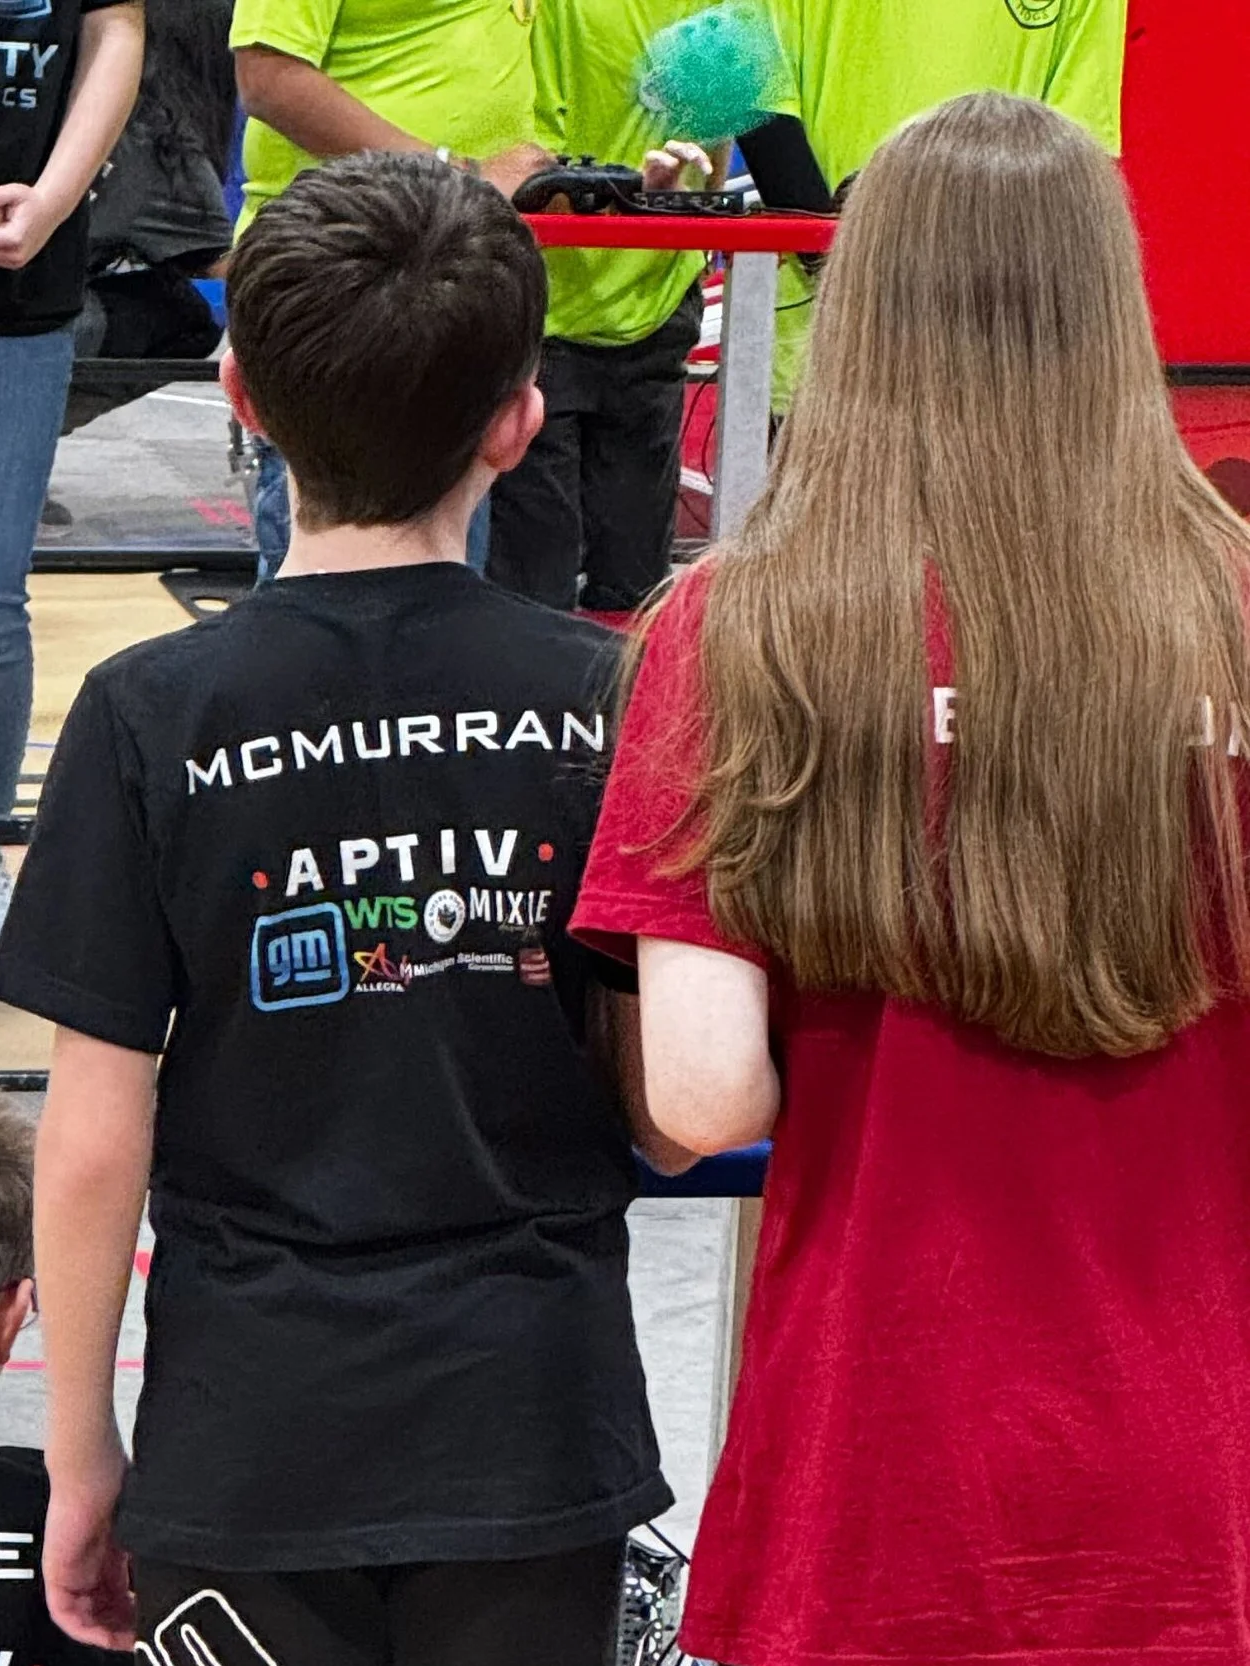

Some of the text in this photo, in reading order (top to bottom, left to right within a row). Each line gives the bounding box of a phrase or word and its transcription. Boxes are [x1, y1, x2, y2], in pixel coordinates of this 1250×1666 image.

[185, 709, 605, 795] MCMURRAN
[285, 829, 519, 897] APTIV
[344, 895, 419, 930] WTS
[469, 886, 553, 925] MIXIE
[267, 928, 332, 986] gm
